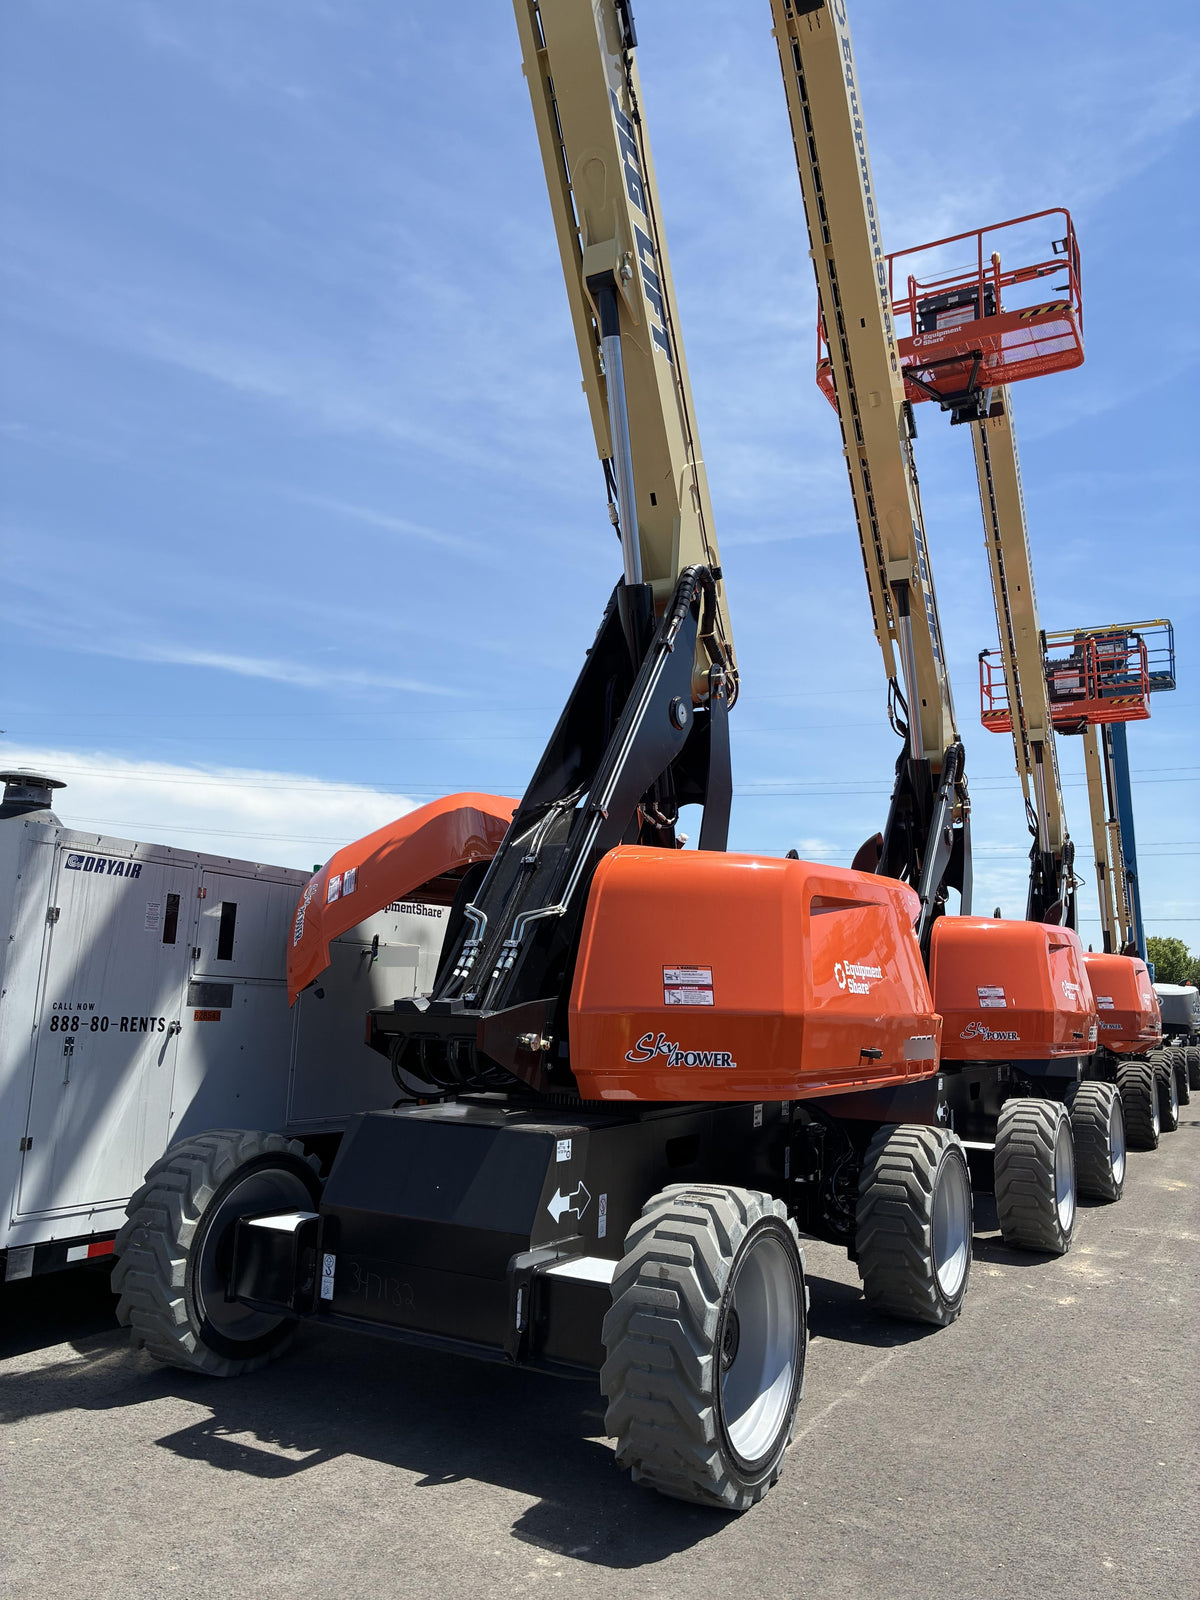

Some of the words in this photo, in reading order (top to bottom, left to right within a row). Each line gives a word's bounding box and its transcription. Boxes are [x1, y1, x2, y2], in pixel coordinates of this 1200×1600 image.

[610, 88, 649, 220] JLG
[633, 222, 674, 365] LIFT
[923, 326, 962, 341] Equipment
[923, 336, 944, 346] Share
[911, 518, 928, 582] JLG
[83, 856, 143, 879] DRYAIR
[843, 960, 883, 980] Equipment
[847, 978, 870, 995] Share
[52, 1002, 73, 1011] CALL
[76, 1002, 96, 1011] NOW
[49, 1015, 166, 1033] 888-80-RENTS
[673, 1051, 733, 1068] POWER
